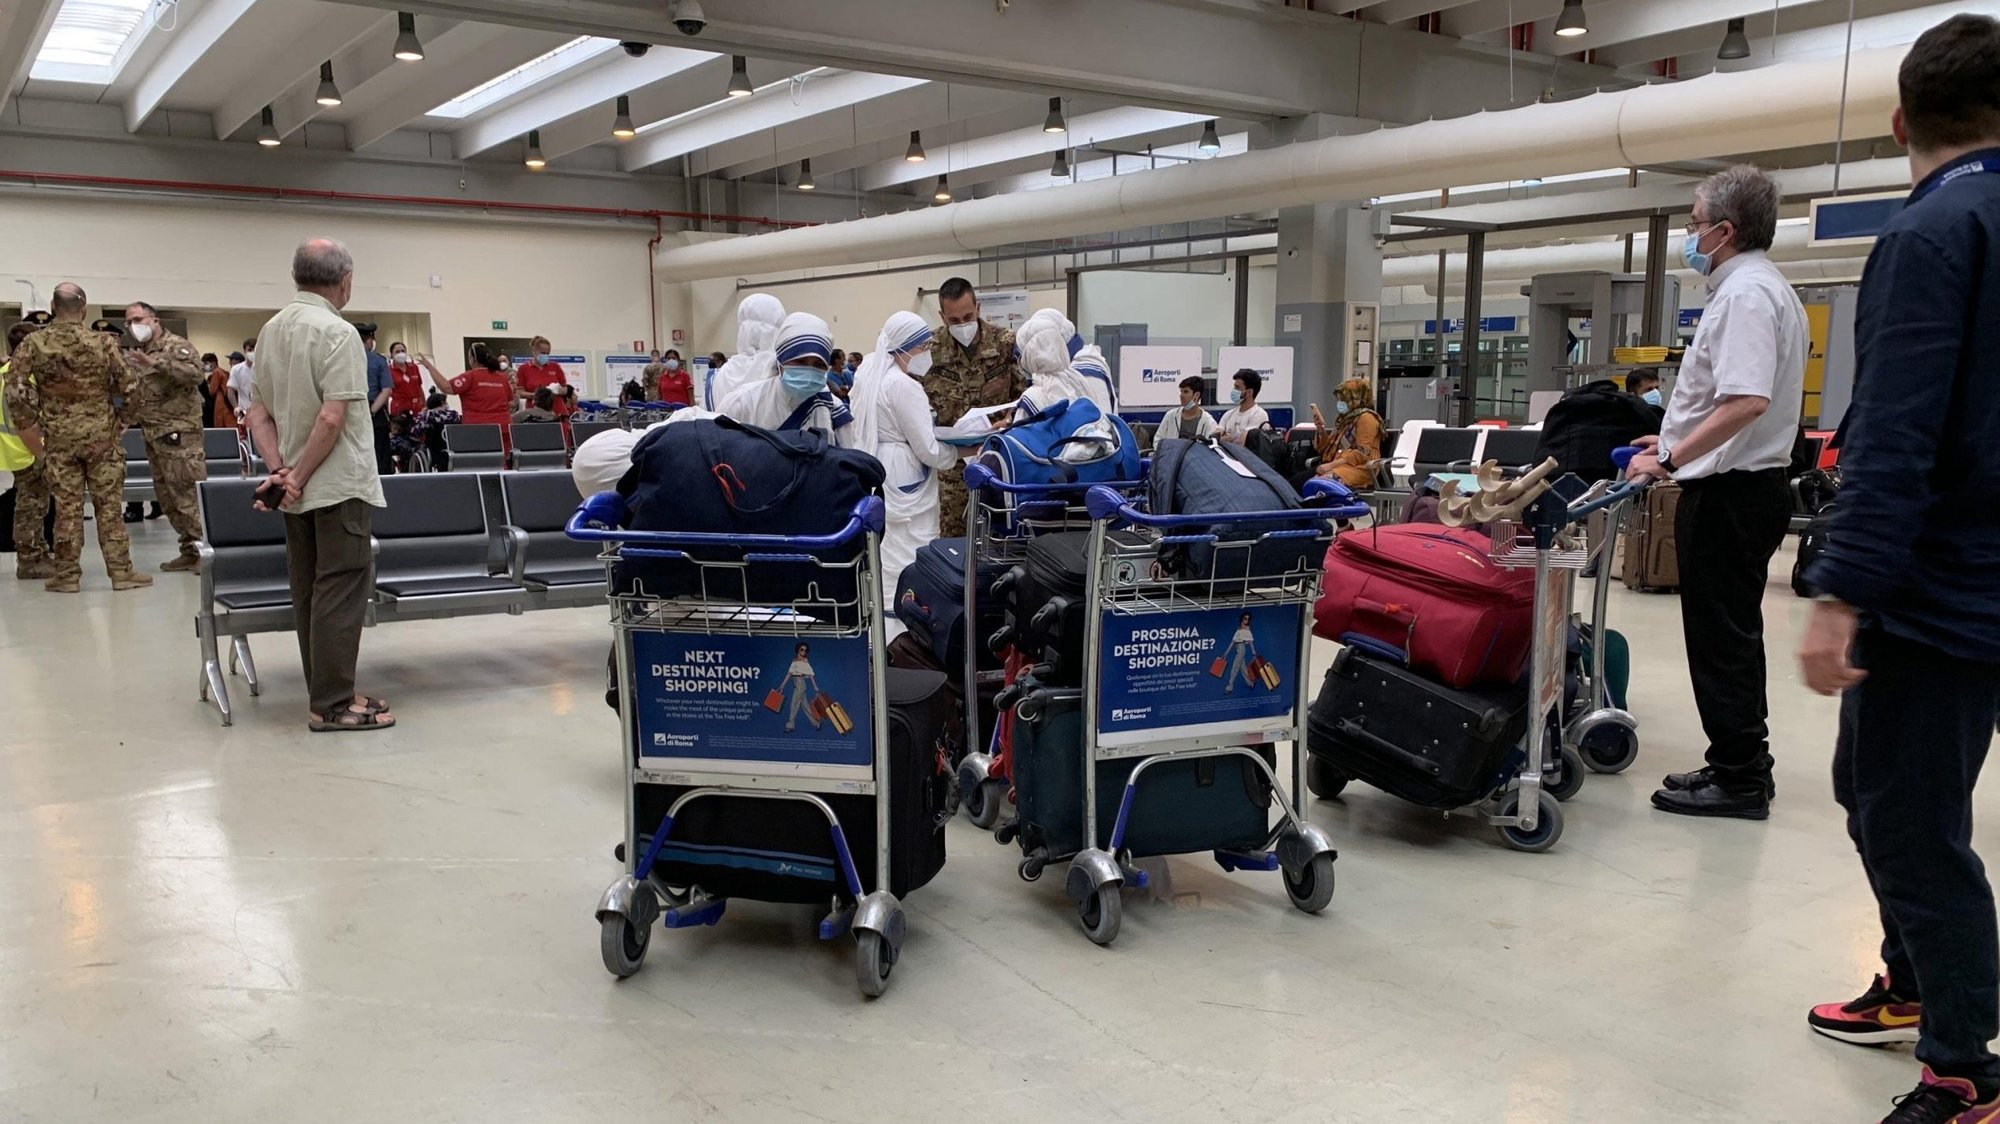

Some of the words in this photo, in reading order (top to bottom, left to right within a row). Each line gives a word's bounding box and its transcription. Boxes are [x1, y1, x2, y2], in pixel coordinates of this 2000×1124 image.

[1131, 626, 1200, 642] PROSSIMA
[1114, 638, 1216, 657] DESTINAZIONE?
[684, 650, 725, 664] NEXT
[1128, 652, 1200, 669] SHOPPING!
[651, 664, 760, 680] DESTINATION?
[665, 680, 748, 694] SHOPPING!
[1123, 706, 1152, 715] Aeroporti
[667, 733, 699, 741] Aeroporti
